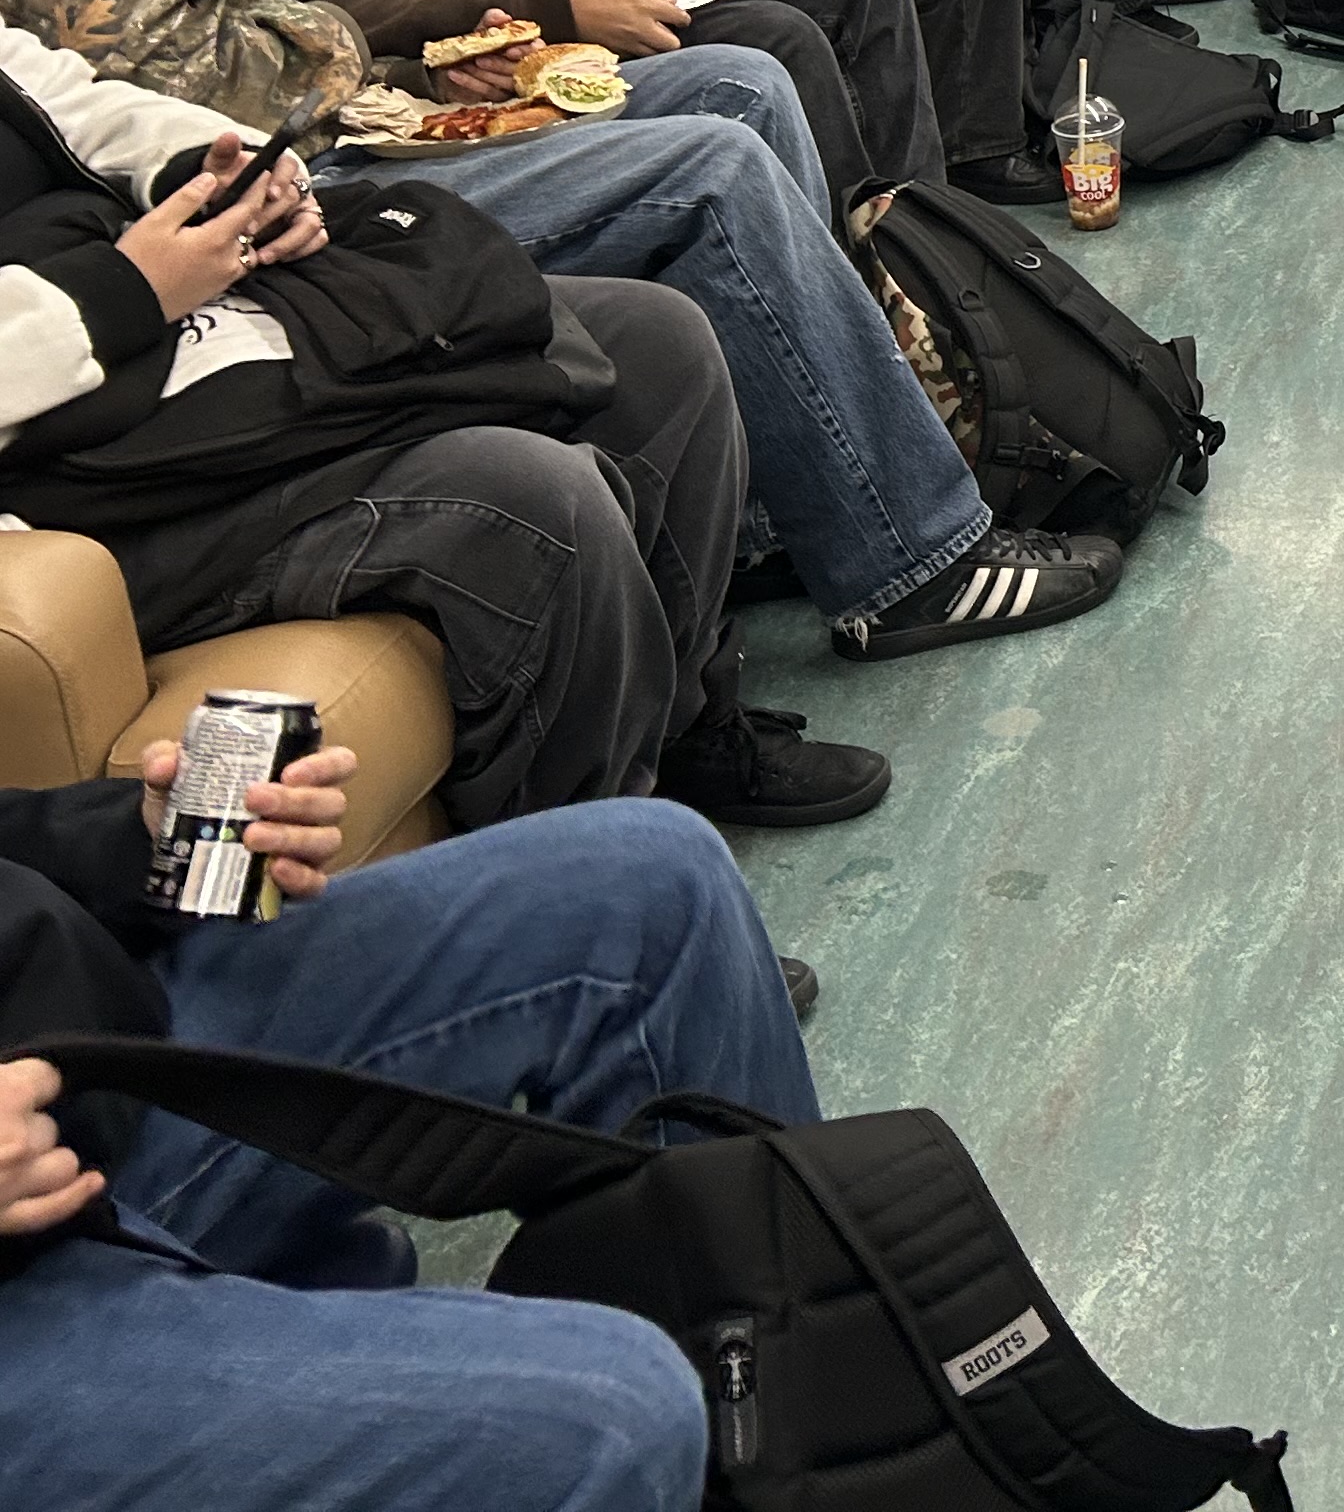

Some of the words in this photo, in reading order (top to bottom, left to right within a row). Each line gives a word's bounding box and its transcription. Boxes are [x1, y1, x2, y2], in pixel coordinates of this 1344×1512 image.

[1072, 171, 1113, 192] Big
[1080, 188, 1107, 201] cool
[959, 1330, 1027, 1382] ROOTS
